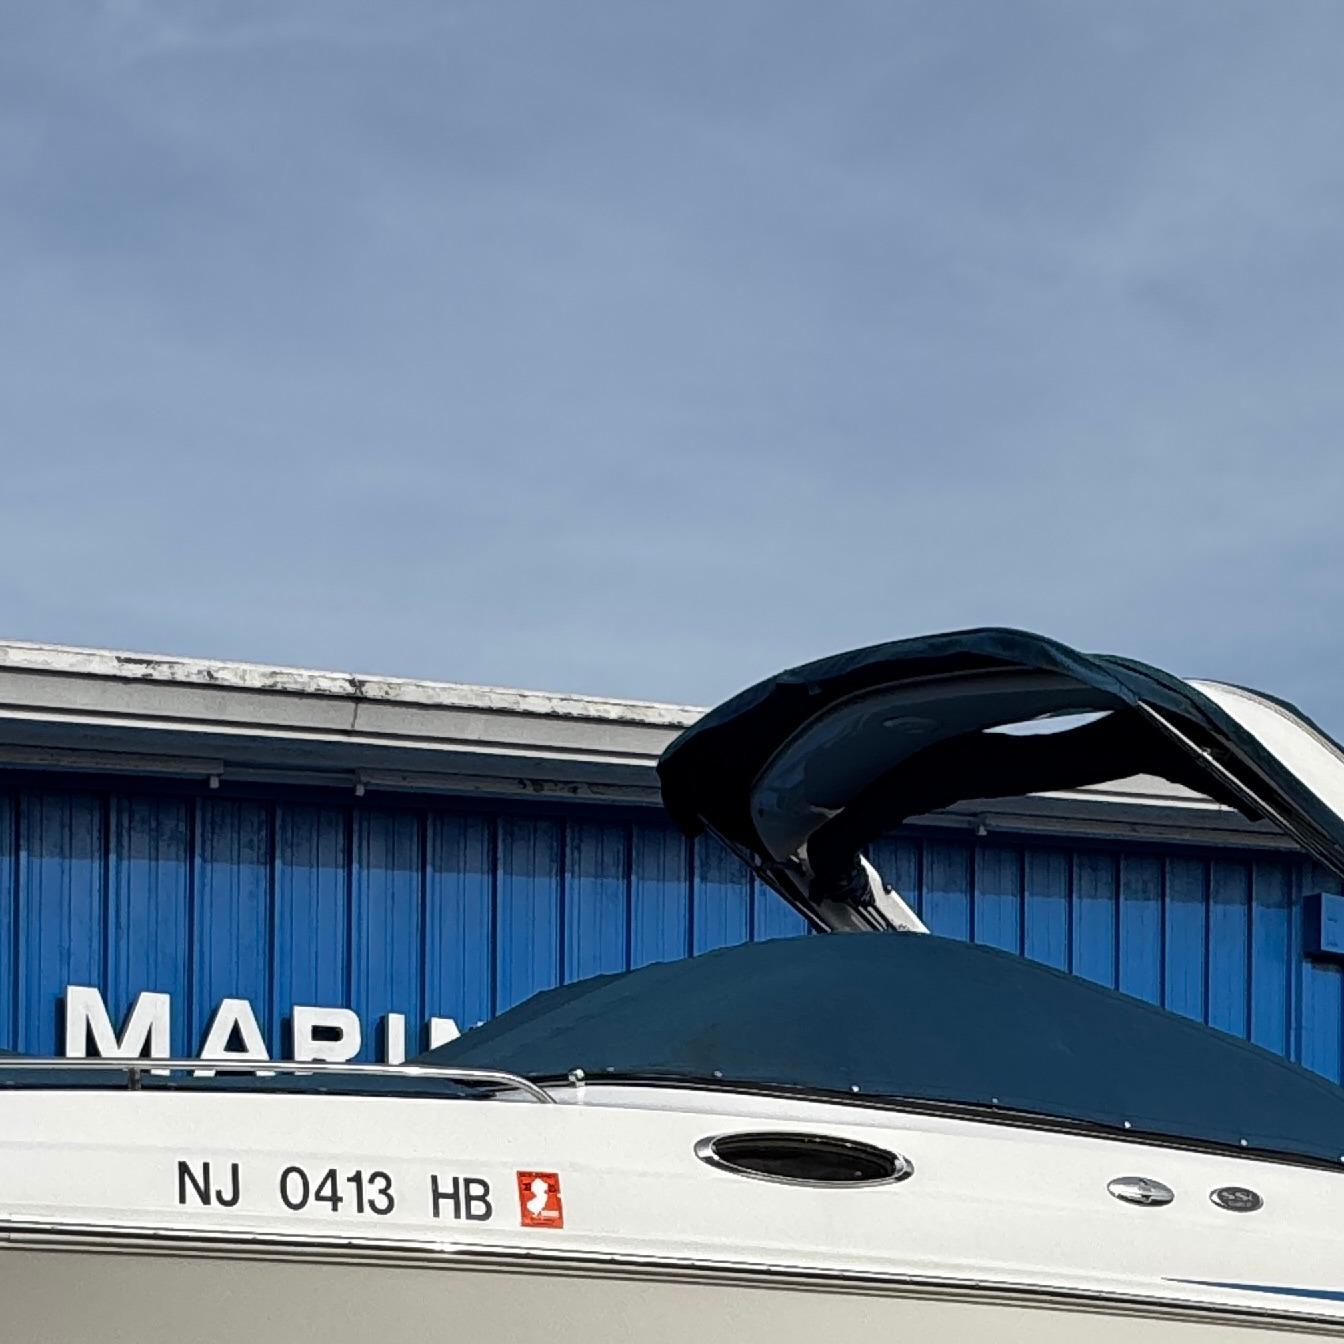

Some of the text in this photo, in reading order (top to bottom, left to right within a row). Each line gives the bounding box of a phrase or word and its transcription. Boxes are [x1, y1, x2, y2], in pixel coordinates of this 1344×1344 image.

[66, 984, 488, 1078] MARI
[177, 1160, 241, 1207] NJ
[279, 1166, 396, 1216] 0413
[431, 1174, 494, 1222] HB
